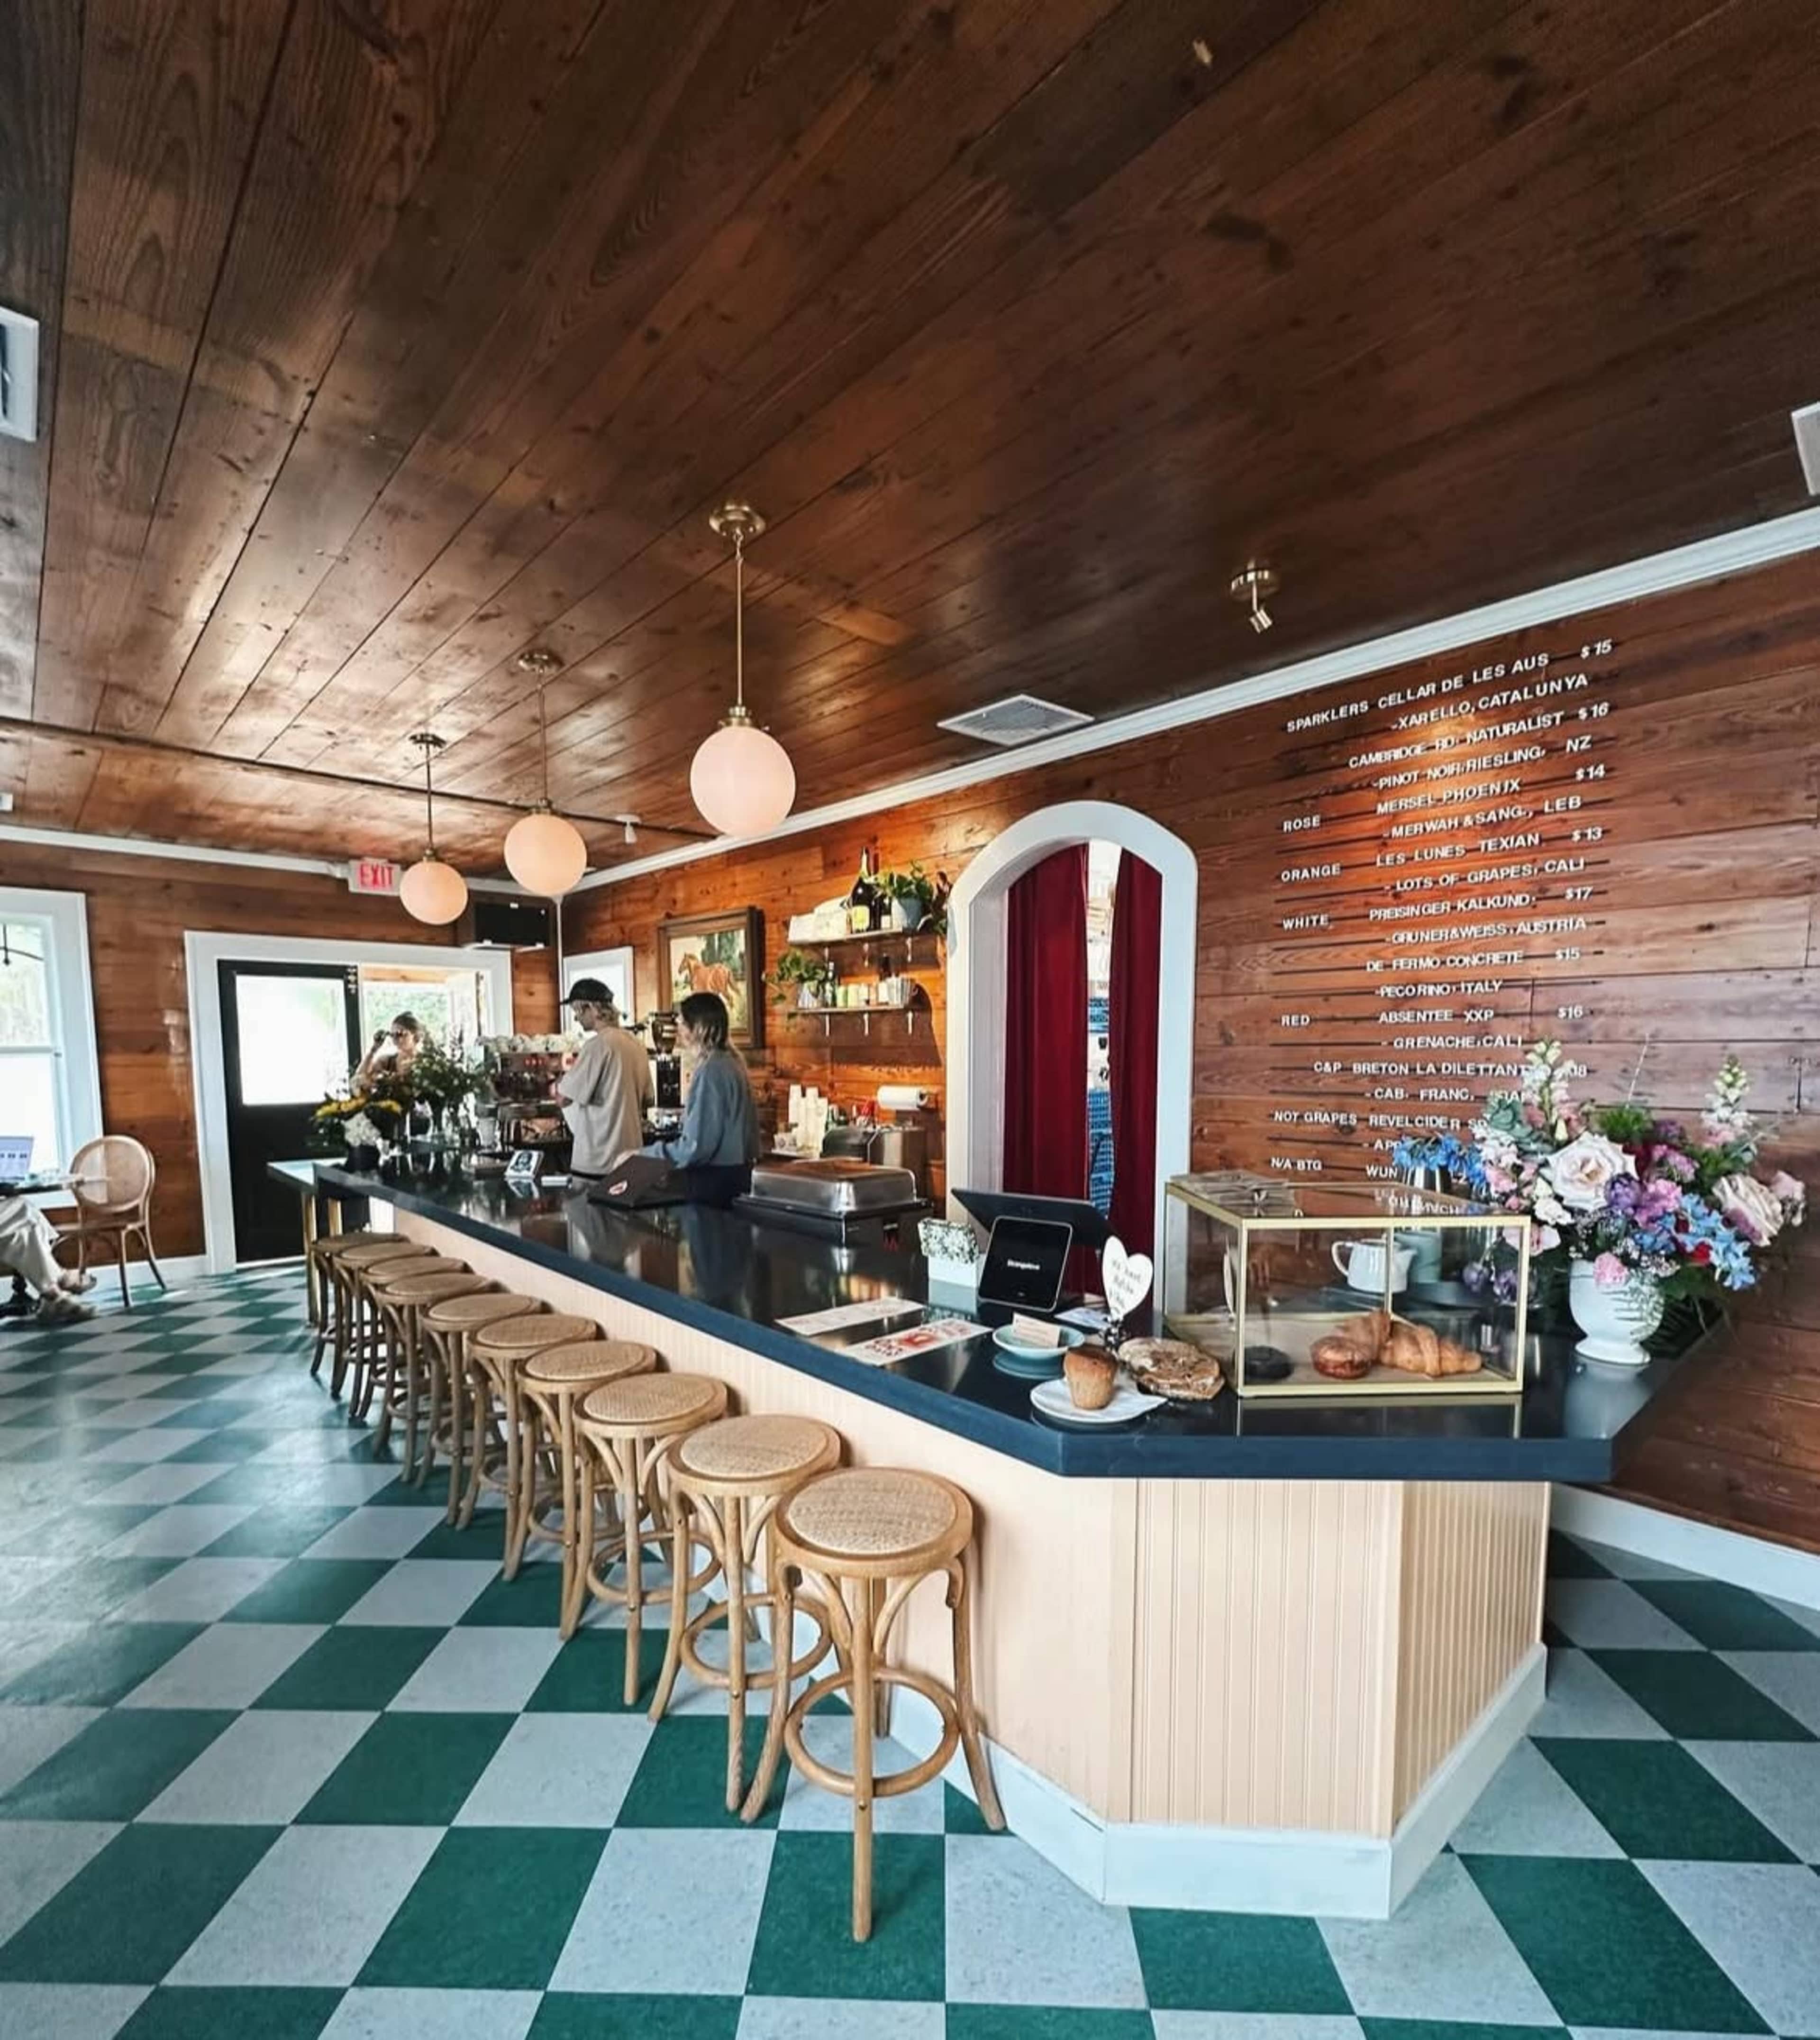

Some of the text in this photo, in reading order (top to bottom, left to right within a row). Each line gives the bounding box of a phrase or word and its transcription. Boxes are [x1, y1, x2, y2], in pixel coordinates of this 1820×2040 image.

[1286, 639, 1612, 733] SPARKLERS CELLAR DE LES AUS $15
[1478, 673, 1588, 710] CATALUNYA
[1349, 742, 1426, 769] CAMBRIDGE
[1466, 711, 1565, 744] NATURALIST
[1578, 702, 1610, 721] $16
[1565, 735, 1592, 753] NZ
[1283, 764, 1605, 833] ROSE MERSEL PHOENIX $14
[1544, 796, 1582, 814] LEB
[1281, 827, 1602, 882] ORANGE LES LUNES TEXIAN $13
[359, 862, 393, 887] EXIT
[1396, 877, 1433, 891] LOTS
[1439, 873, 1461, 886] OF
[1544, 858, 1585, 873] CALI
[1282, 915, 1329, 931] WHITE
[1565, 887, 1593, 901] $17
[1516, 917, 1587, 934] AUSTRIA
[1366, 949, 1580, 972] DE FERMO CONCRETE $15
[1460, 980, 1503, 994] ITALY
[1281, 1006, 1583, 1027] RED ABSENTEE XXP $16
[1483, 1035, 1522, 1047] CALI
[1352, 1062, 1409, 1075] BRETON
[1416, 1063, 1437, 1074] LA
[1441, 1062, 1531, 1077] DILETTANT
[1274, 1111, 1299, 1122] NOT
[1304, 1112, 1358, 1126] GRAPES
[1270, 1157, 1292, 1170] N/A
[1296, 1159, 1322, 1171] BTG
